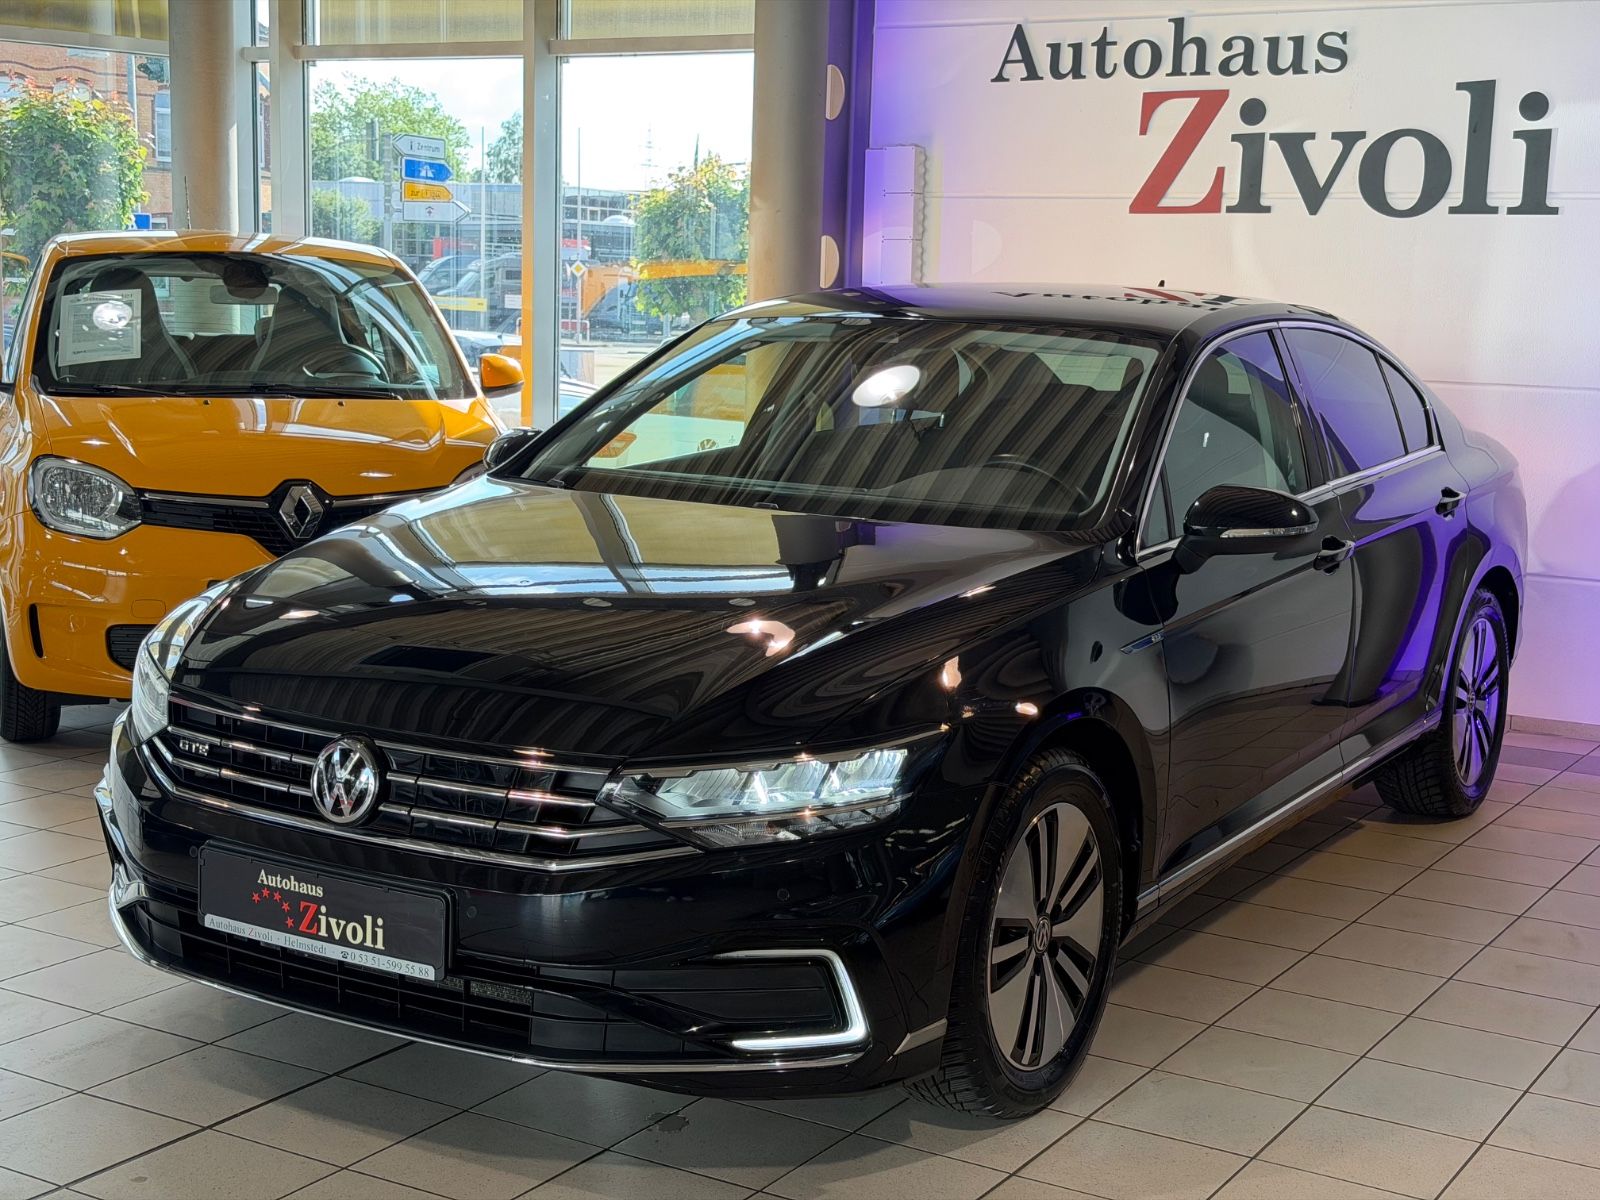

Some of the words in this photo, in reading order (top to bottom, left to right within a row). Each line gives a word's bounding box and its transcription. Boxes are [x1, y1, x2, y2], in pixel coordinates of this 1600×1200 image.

[990, 17, 1349, 82] Autohaus
[416, 142, 441, 153] Zentrum
[1129, 79, 1559, 218] Zivoli
[257, 869, 324, 898] Autohaus
[208, 917, 246, 935] Autohaus
[248, 927, 273, 942] Zivoli
[284, 935, 327, 955] Helmstedt
[418, 968, 430, 978] 88
[299, 901, 386, 950] Zivoli
